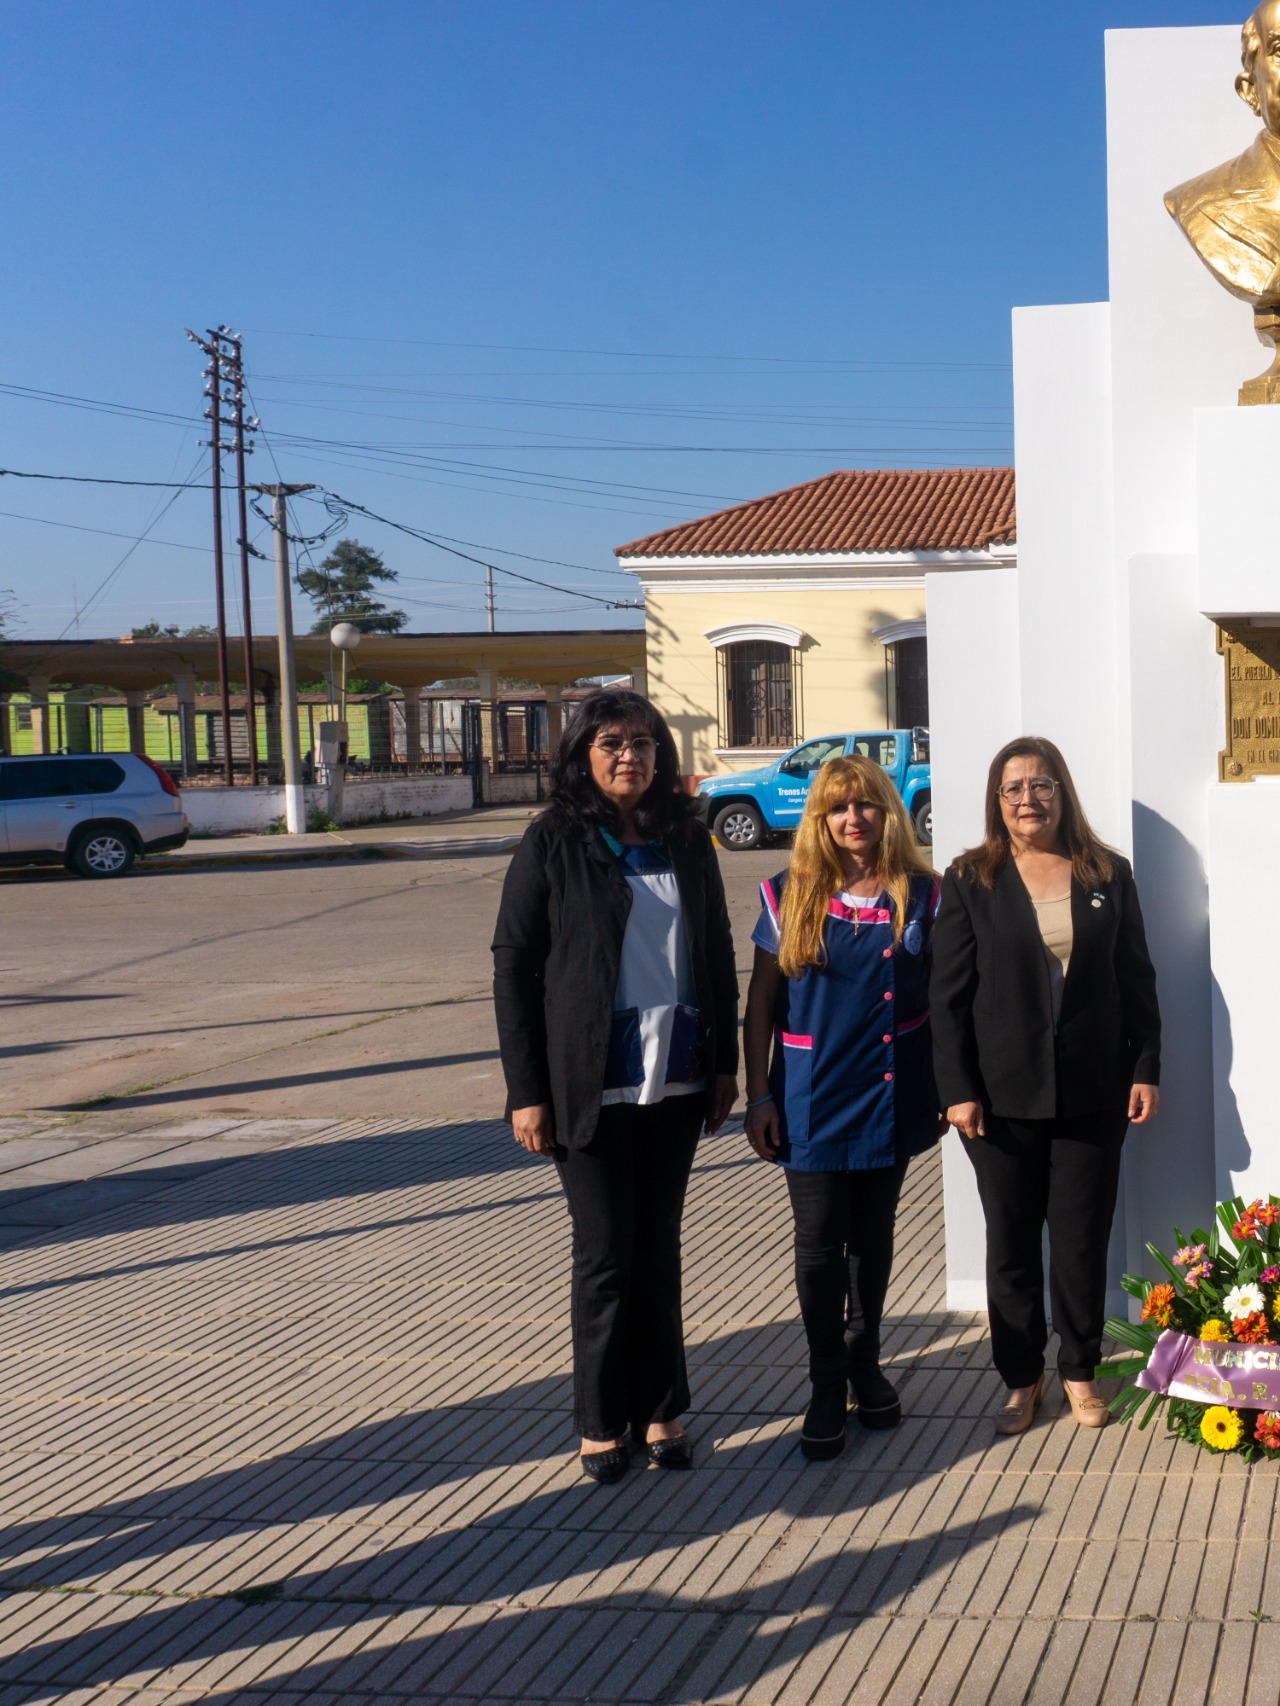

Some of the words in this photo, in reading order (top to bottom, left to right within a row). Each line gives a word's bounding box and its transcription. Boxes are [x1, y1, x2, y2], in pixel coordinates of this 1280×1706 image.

[1231, 666, 1243, 680] EL
[1245, 666, 1272, 680] PUEBLO
[1262, 690, 1275, 706] AL
[1232, 716, 1251, 739] DON
[1247, 750, 1256, 763] EN
[1258, 749, 1266, 763] EL
[777, 787, 800, 796] Trenes
[1252, 1382, 1278, 1402] R.
